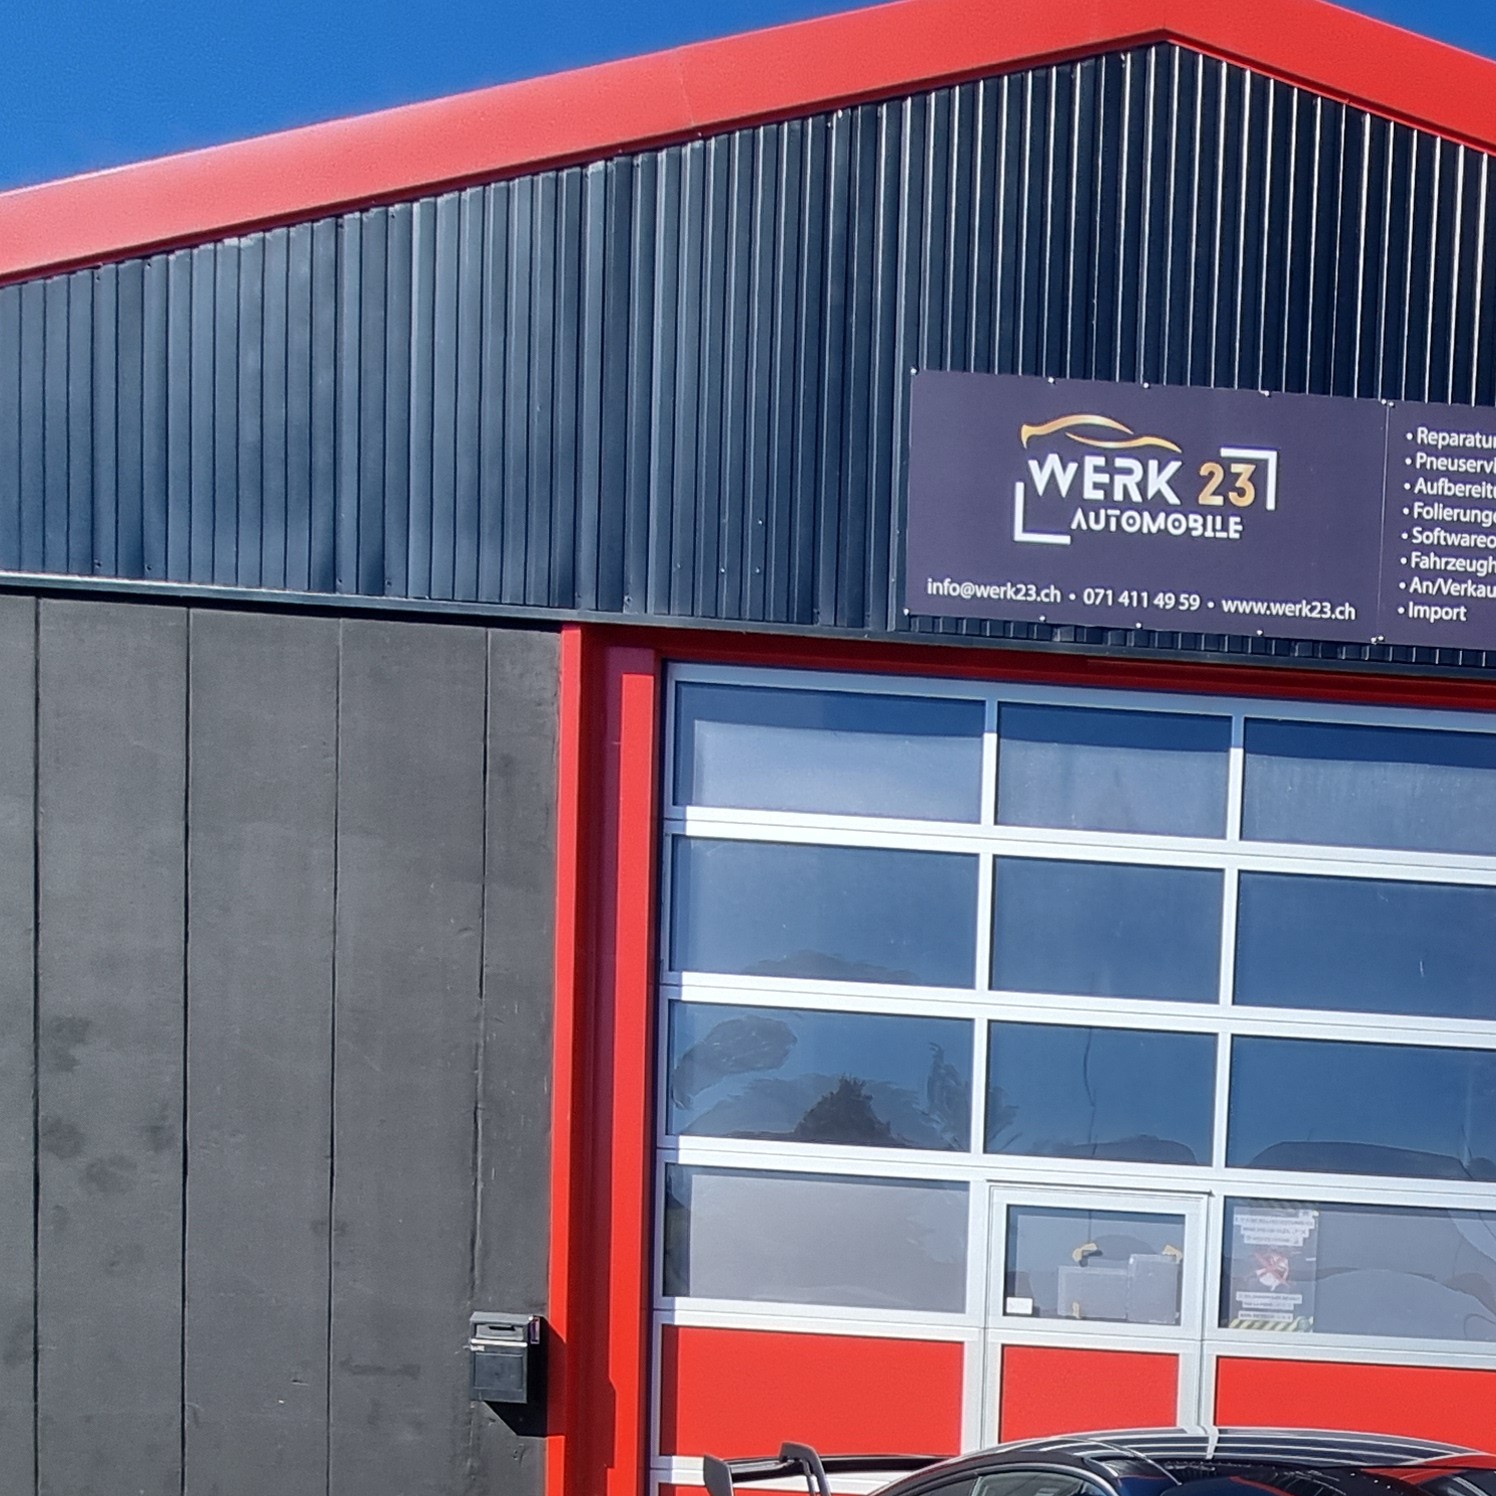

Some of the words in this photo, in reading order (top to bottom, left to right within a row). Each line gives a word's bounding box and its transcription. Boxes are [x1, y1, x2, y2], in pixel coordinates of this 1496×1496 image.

[1027, 453, 1183, 506] WERK
[1198, 462, 1256, 507] 23
[1070, 507, 1243, 539] AUTOMOBILE
[926, 577, 1062, 603] info@werk23.ch
[1082, 587, 1113, 606] 071
[1117, 590, 1148, 609] 411
[1152, 592, 1176, 610] 49
[1178, 593, 1201, 611] 59
[1221, 599, 1356, 621] www.werk23.ch
[1407, 600, 1468, 623] Import
